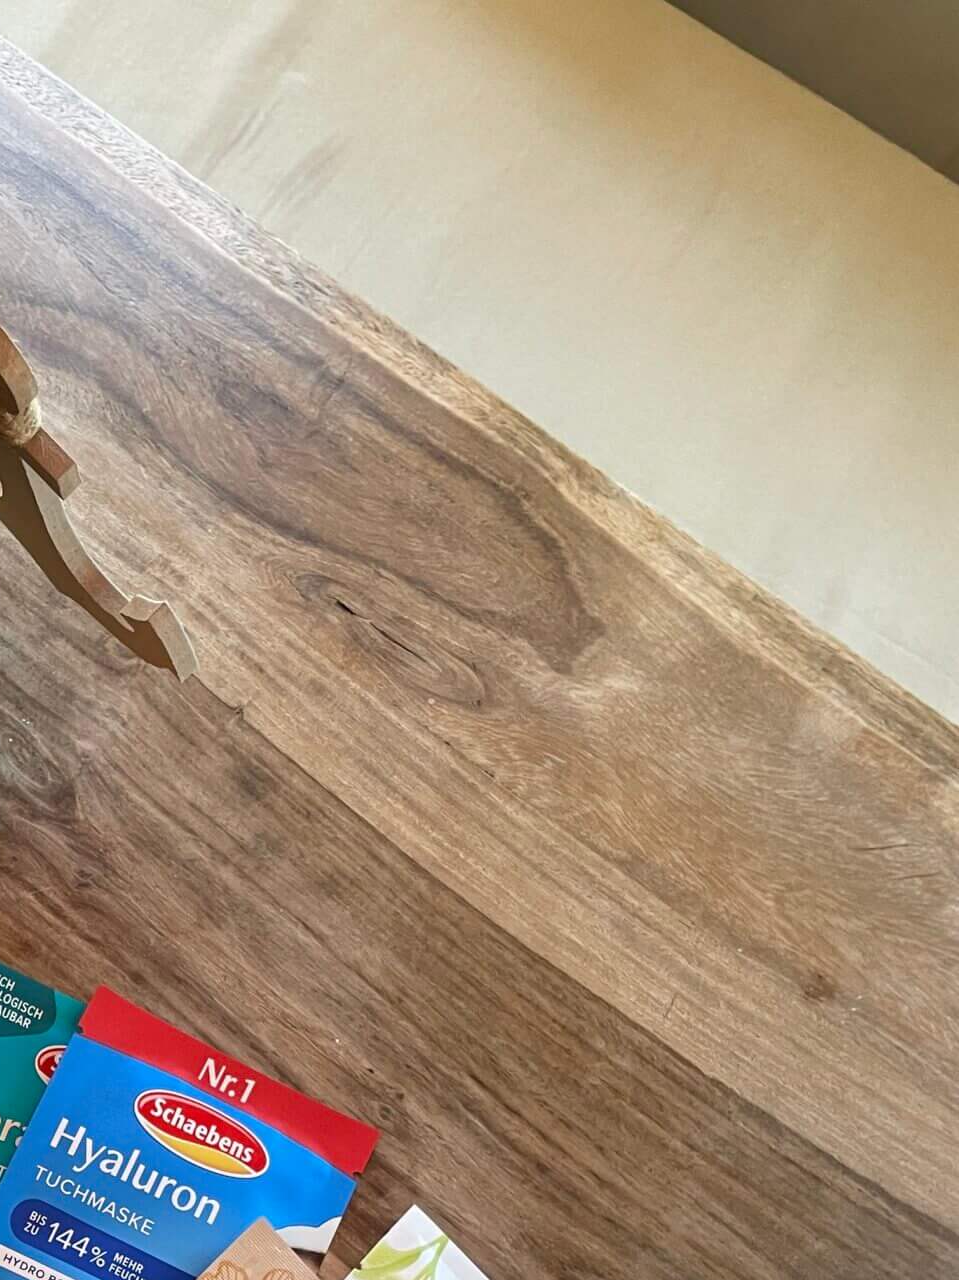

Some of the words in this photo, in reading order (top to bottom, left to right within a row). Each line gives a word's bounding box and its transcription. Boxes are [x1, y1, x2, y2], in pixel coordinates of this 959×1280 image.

[198, 1057, 257, 1104] Nr.1
[150, 1098, 256, 1165] Schaebens
[49, 1117, 222, 1226] Hyaluron
[29, 1211, 48, 1226] BIS
[35, 1165, 156, 1236] TUCHMASKE
[24, 1222, 40, 1236] ZU
[3, 1253, 45, 1279] HYDRO
[113, 1252, 144, 1273] MEHR
